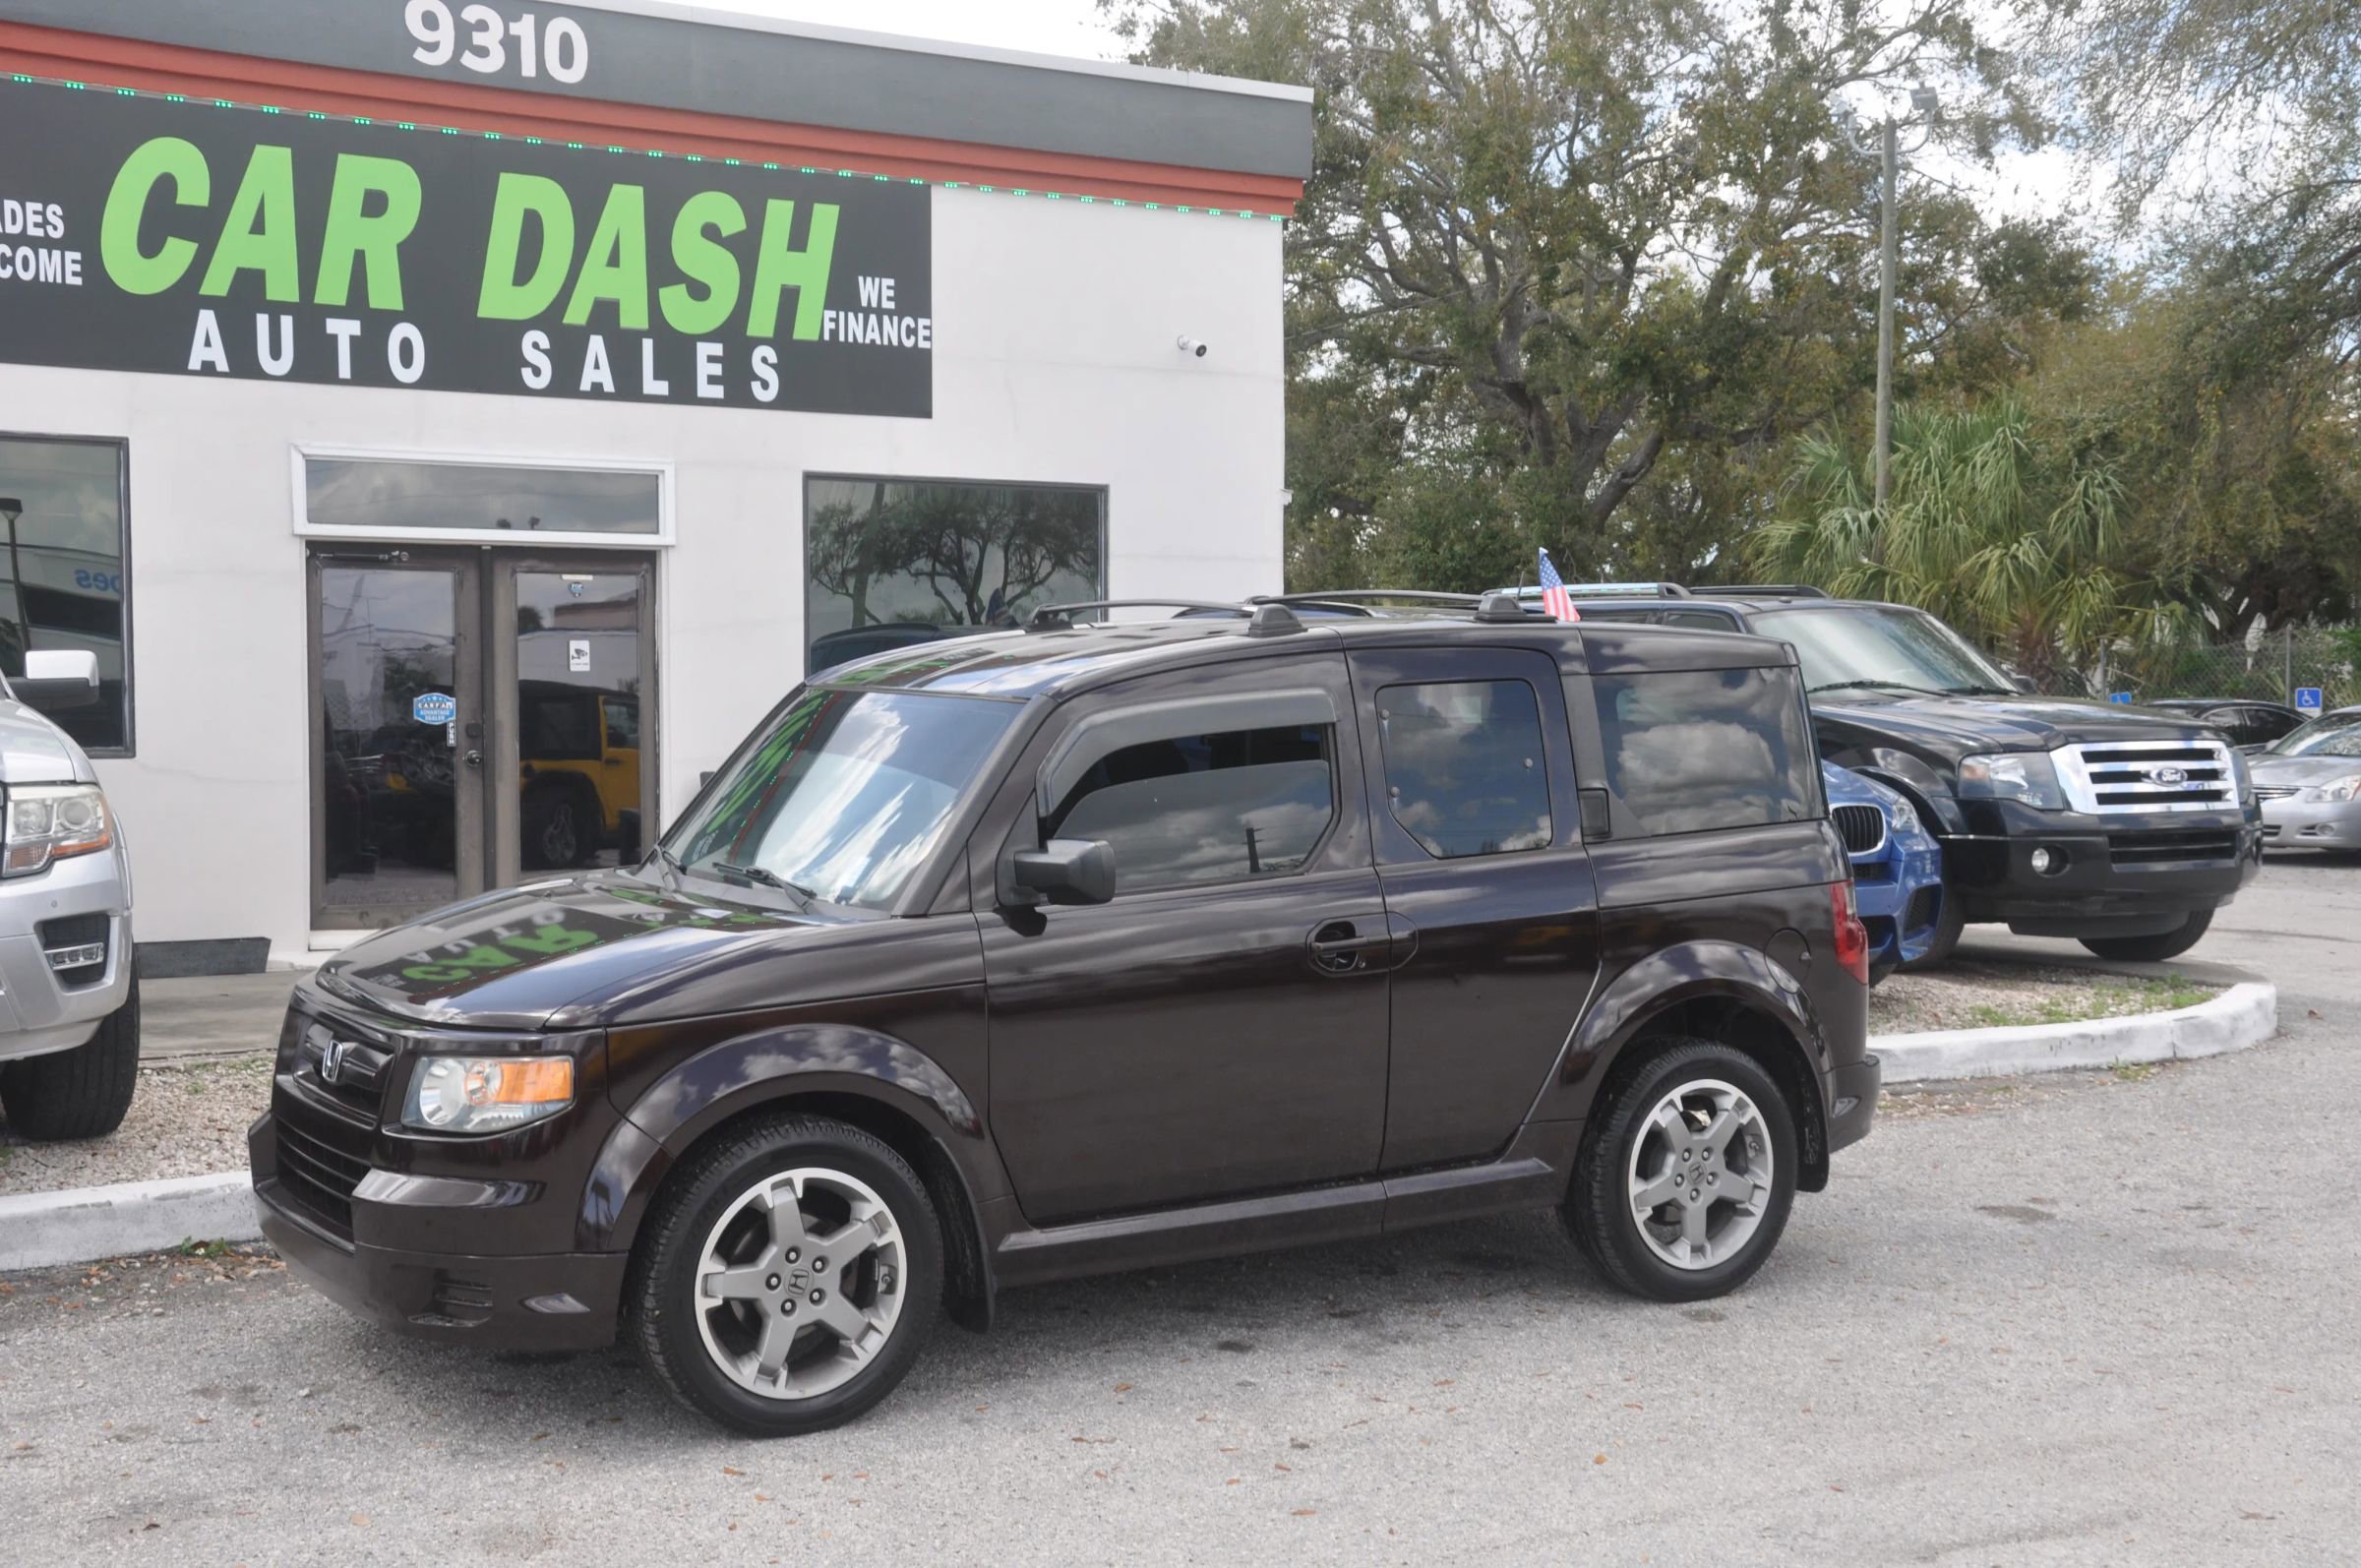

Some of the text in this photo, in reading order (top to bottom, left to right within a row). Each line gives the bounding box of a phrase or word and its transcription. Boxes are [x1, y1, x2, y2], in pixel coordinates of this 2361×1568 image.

[404, 0, 588, 85] 9310
[0, 199, 65, 239] DES
[100, 137, 840, 340] CAR DASH
[858, 275, 895, 310] WE
[187, 309, 779, 402] AUTO SALES
[822, 309, 932, 349] FINANCE
